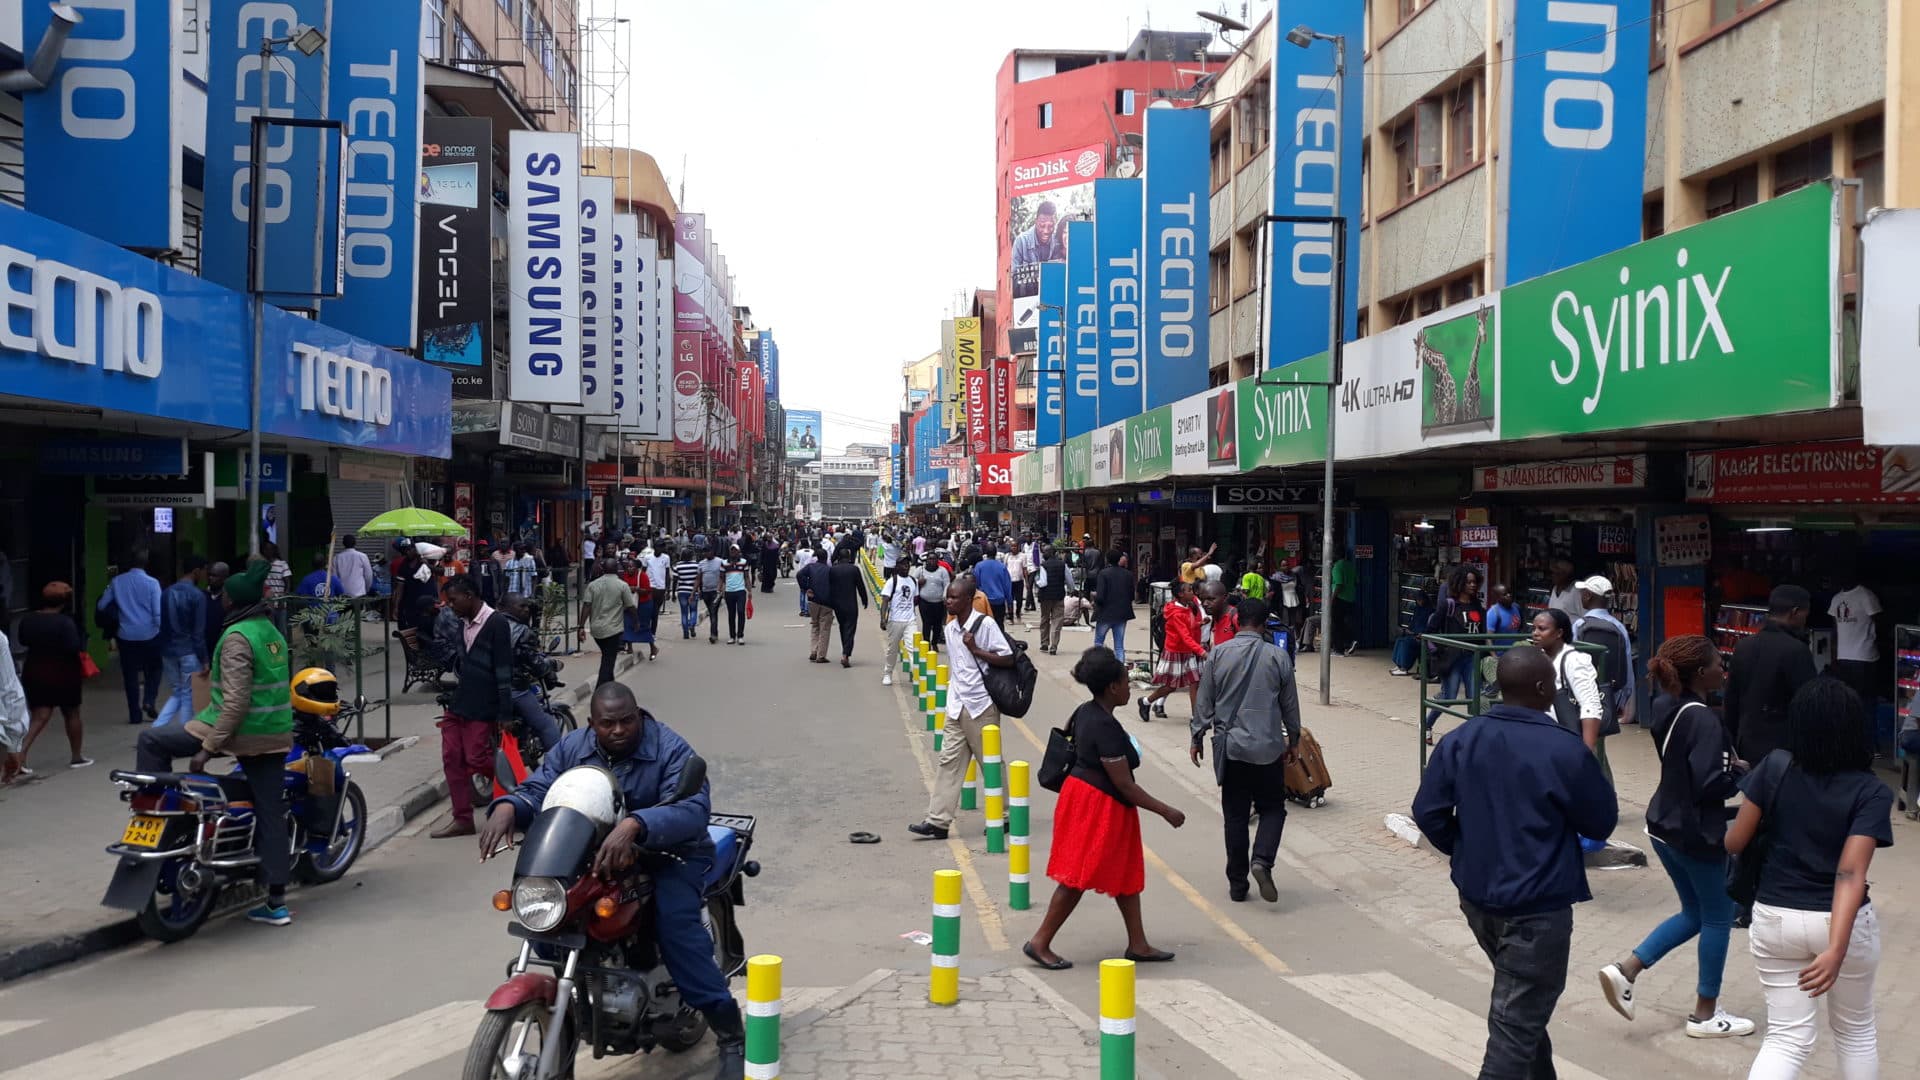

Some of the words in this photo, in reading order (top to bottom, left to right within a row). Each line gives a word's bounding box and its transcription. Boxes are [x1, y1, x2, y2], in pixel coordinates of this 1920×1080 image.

[345, 49, 398, 278] TECNO
[1014, 158, 1069, 182] SanDisk
[526, 153, 563, 377] SAMSUNG
[682, 231, 697, 241] LG
[1160, 192, 1195, 358] TECNO
[0, 244, 163, 378] ECNO
[1108, 248, 1139, 386] TECNO
[1550, 247, 1735, 415] Syinix
[292, 341, 393, 426] TECNO
[680, 353, 694, 362] LG
[517, 411, 538, 434] SONY
[970, 376, 985, 438] SanDisk
[997, 366, 1008, 434] SanDisk
[1177, 414, 1195, 435] SMART
[1195, 413, 1203, 432] TV
[1254, 370, 1312, 458] Syinix
[1342, 377, 1361, 413] 4K
[1363, 384, 1392, 409] ULTRA
[1393, 379, 1415, 402] HD
[1133, 416, 1163, 475] Syinix
[1503, 468, 1536, 487] AJMAN
[1537, 463, 1604, 485] ELECTRONICS
[1763, 449, 1876, 474] ELECTRONICS
[1228, 487, 1305, 502] SONY
[1462, 530, 1498, 543] REPAIR
